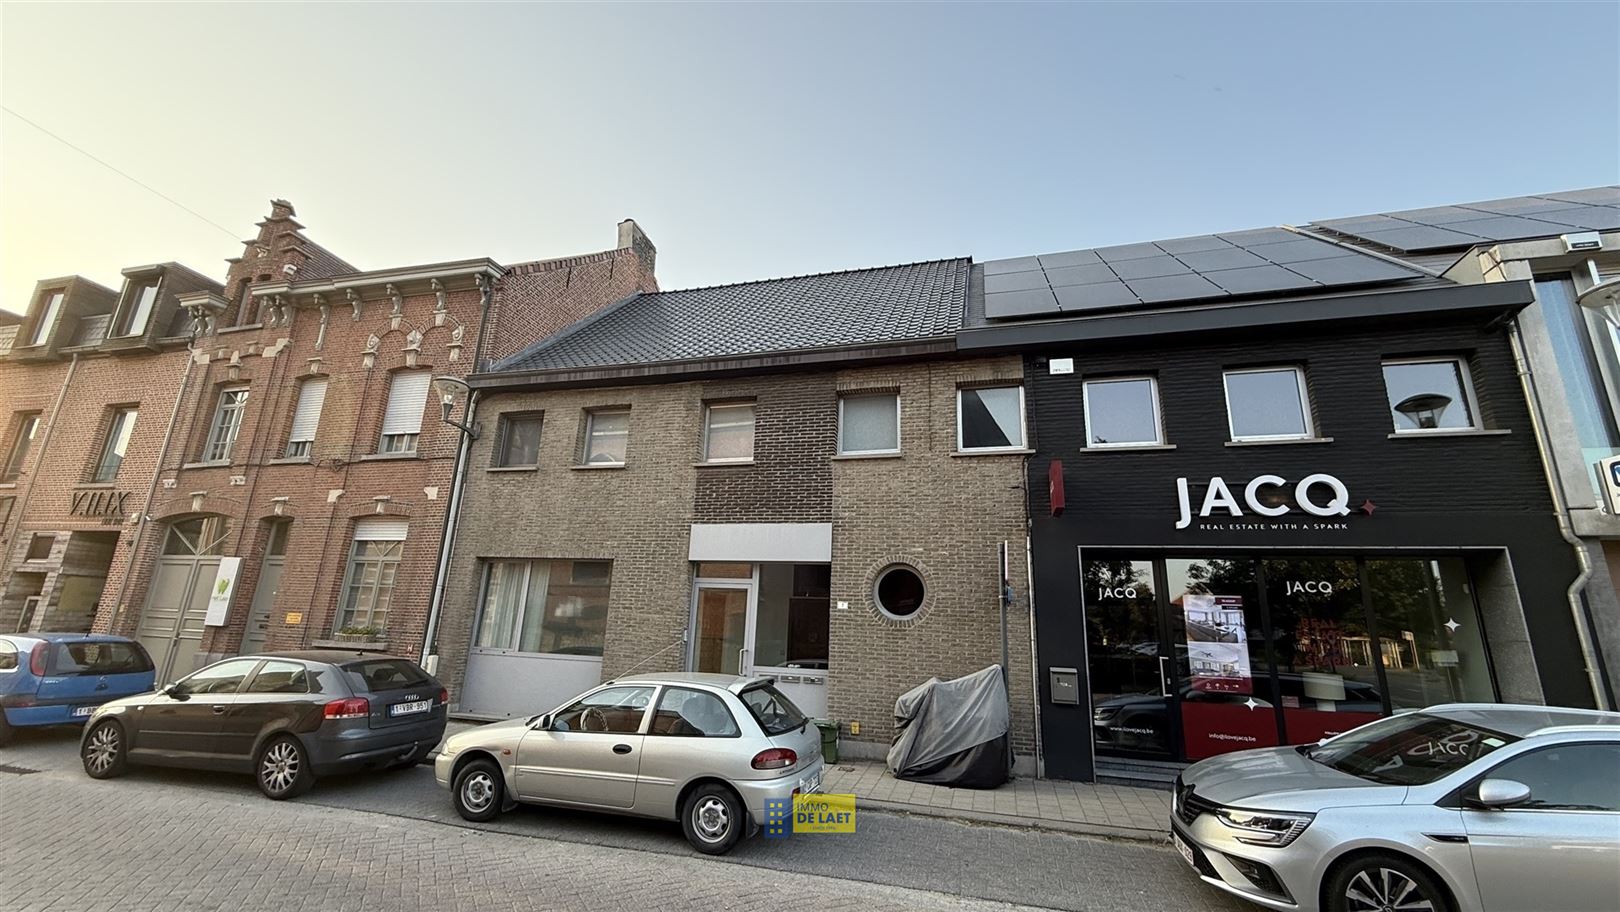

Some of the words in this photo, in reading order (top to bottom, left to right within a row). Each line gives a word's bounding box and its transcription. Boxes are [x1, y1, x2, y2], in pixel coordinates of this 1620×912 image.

[1175, 473, 1351, 529] JACQ
[1098, 587, 1137, 601] JACQ
[1286, 581, 1333, 596] JACQ
